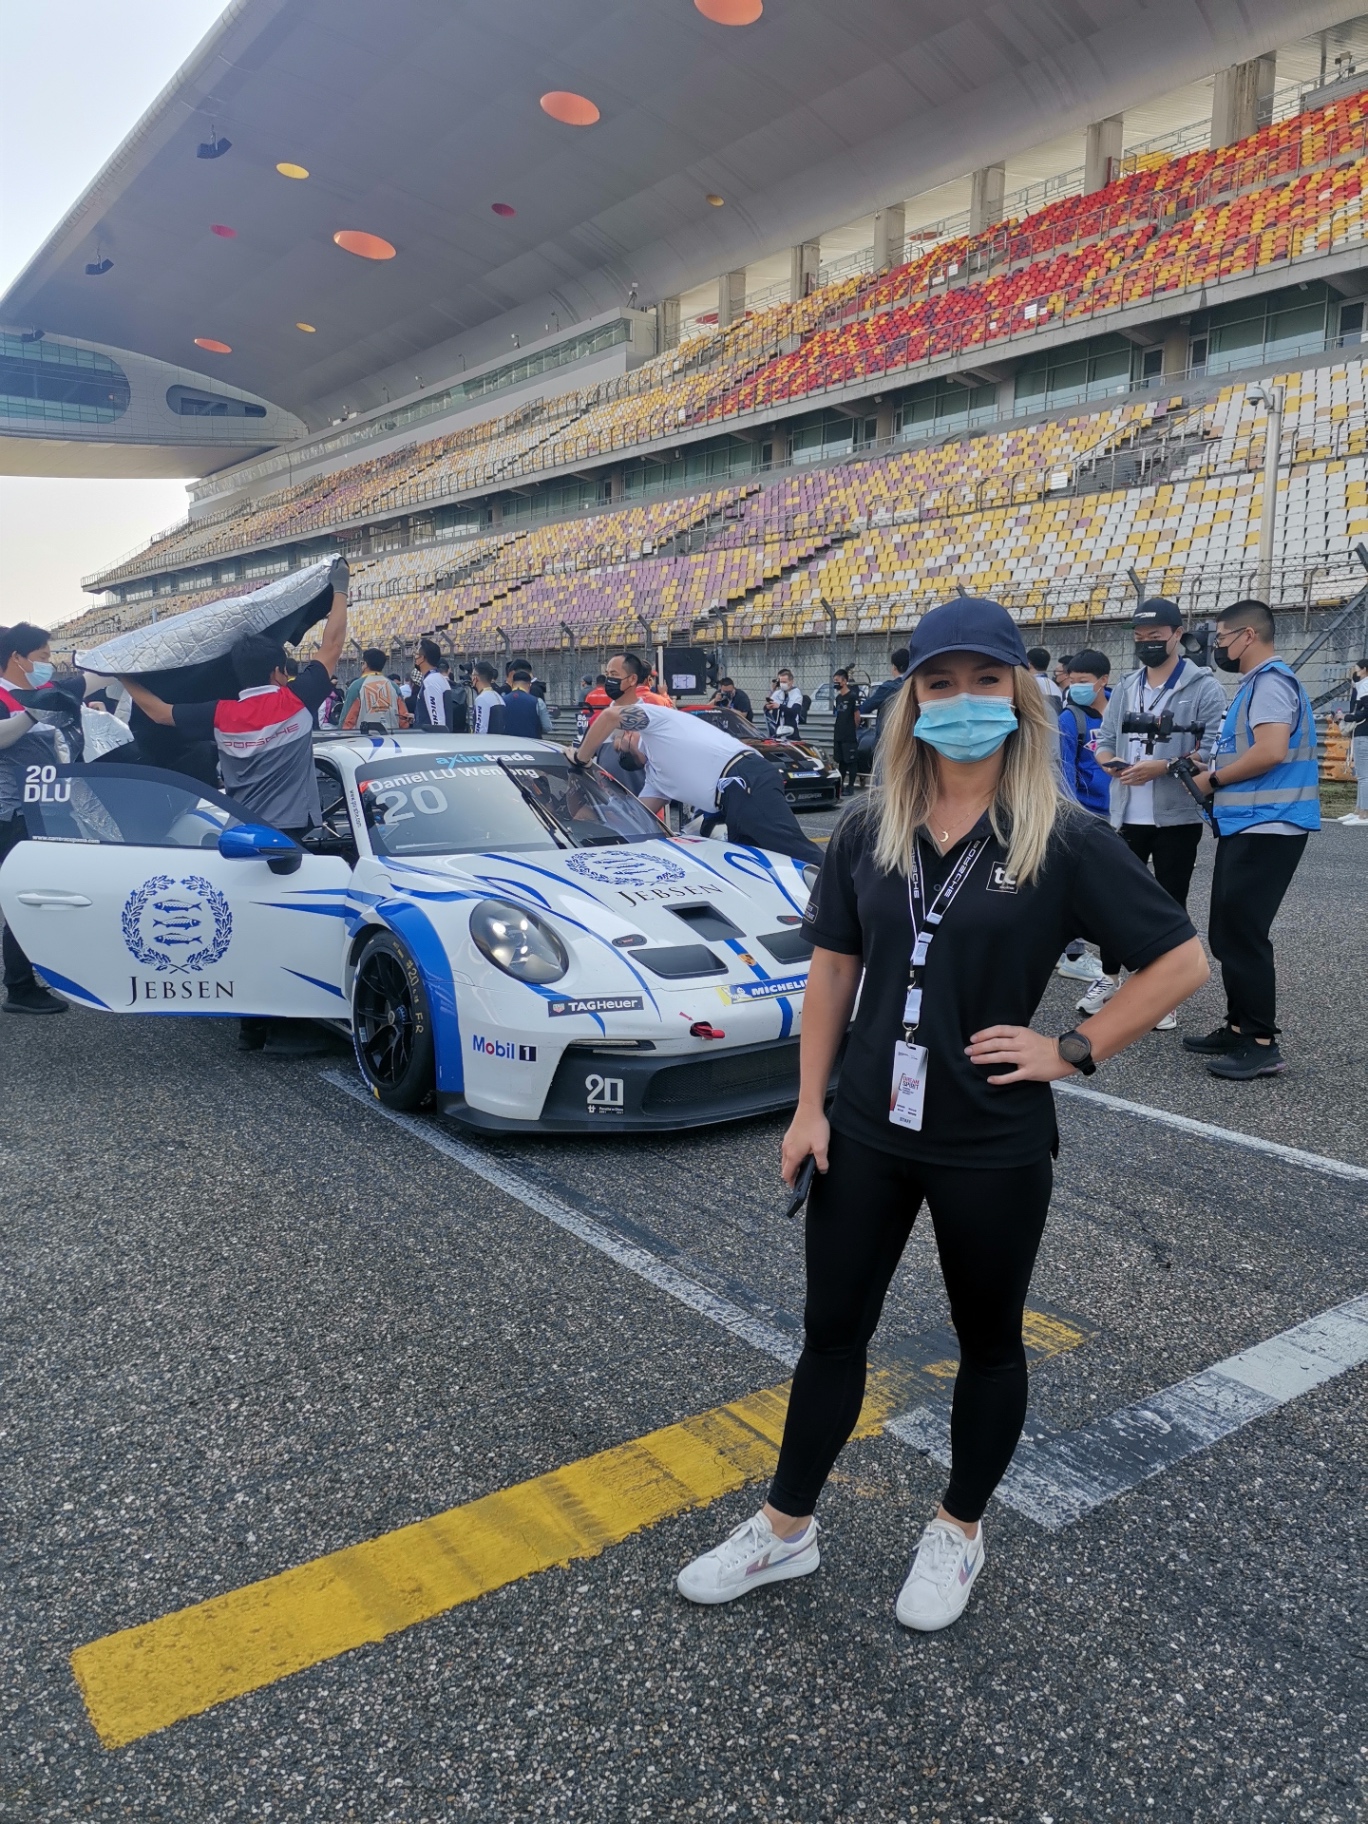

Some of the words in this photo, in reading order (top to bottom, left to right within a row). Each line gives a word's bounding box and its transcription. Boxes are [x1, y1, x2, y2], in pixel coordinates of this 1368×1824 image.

[223, 723, 299, 748] PORSCHE
[435, 752, 535, 769] aximtrade
[25, 765, 57, 783] 20
[368, 772, 428, 793] Daniel
[429, 769, 456, 780] LU
[23, 784, 71, 803] DLU
[376, 785, 448, 826] 20
[944, 840, 981, 898] PORSCHE
[614, 884, 723, 907] JEBSEN
[125, 976, 235, 1006] JEBSEN
[473, 1034, 515, 1060] Mobil
[585, 1073, 624, 1106] 20
